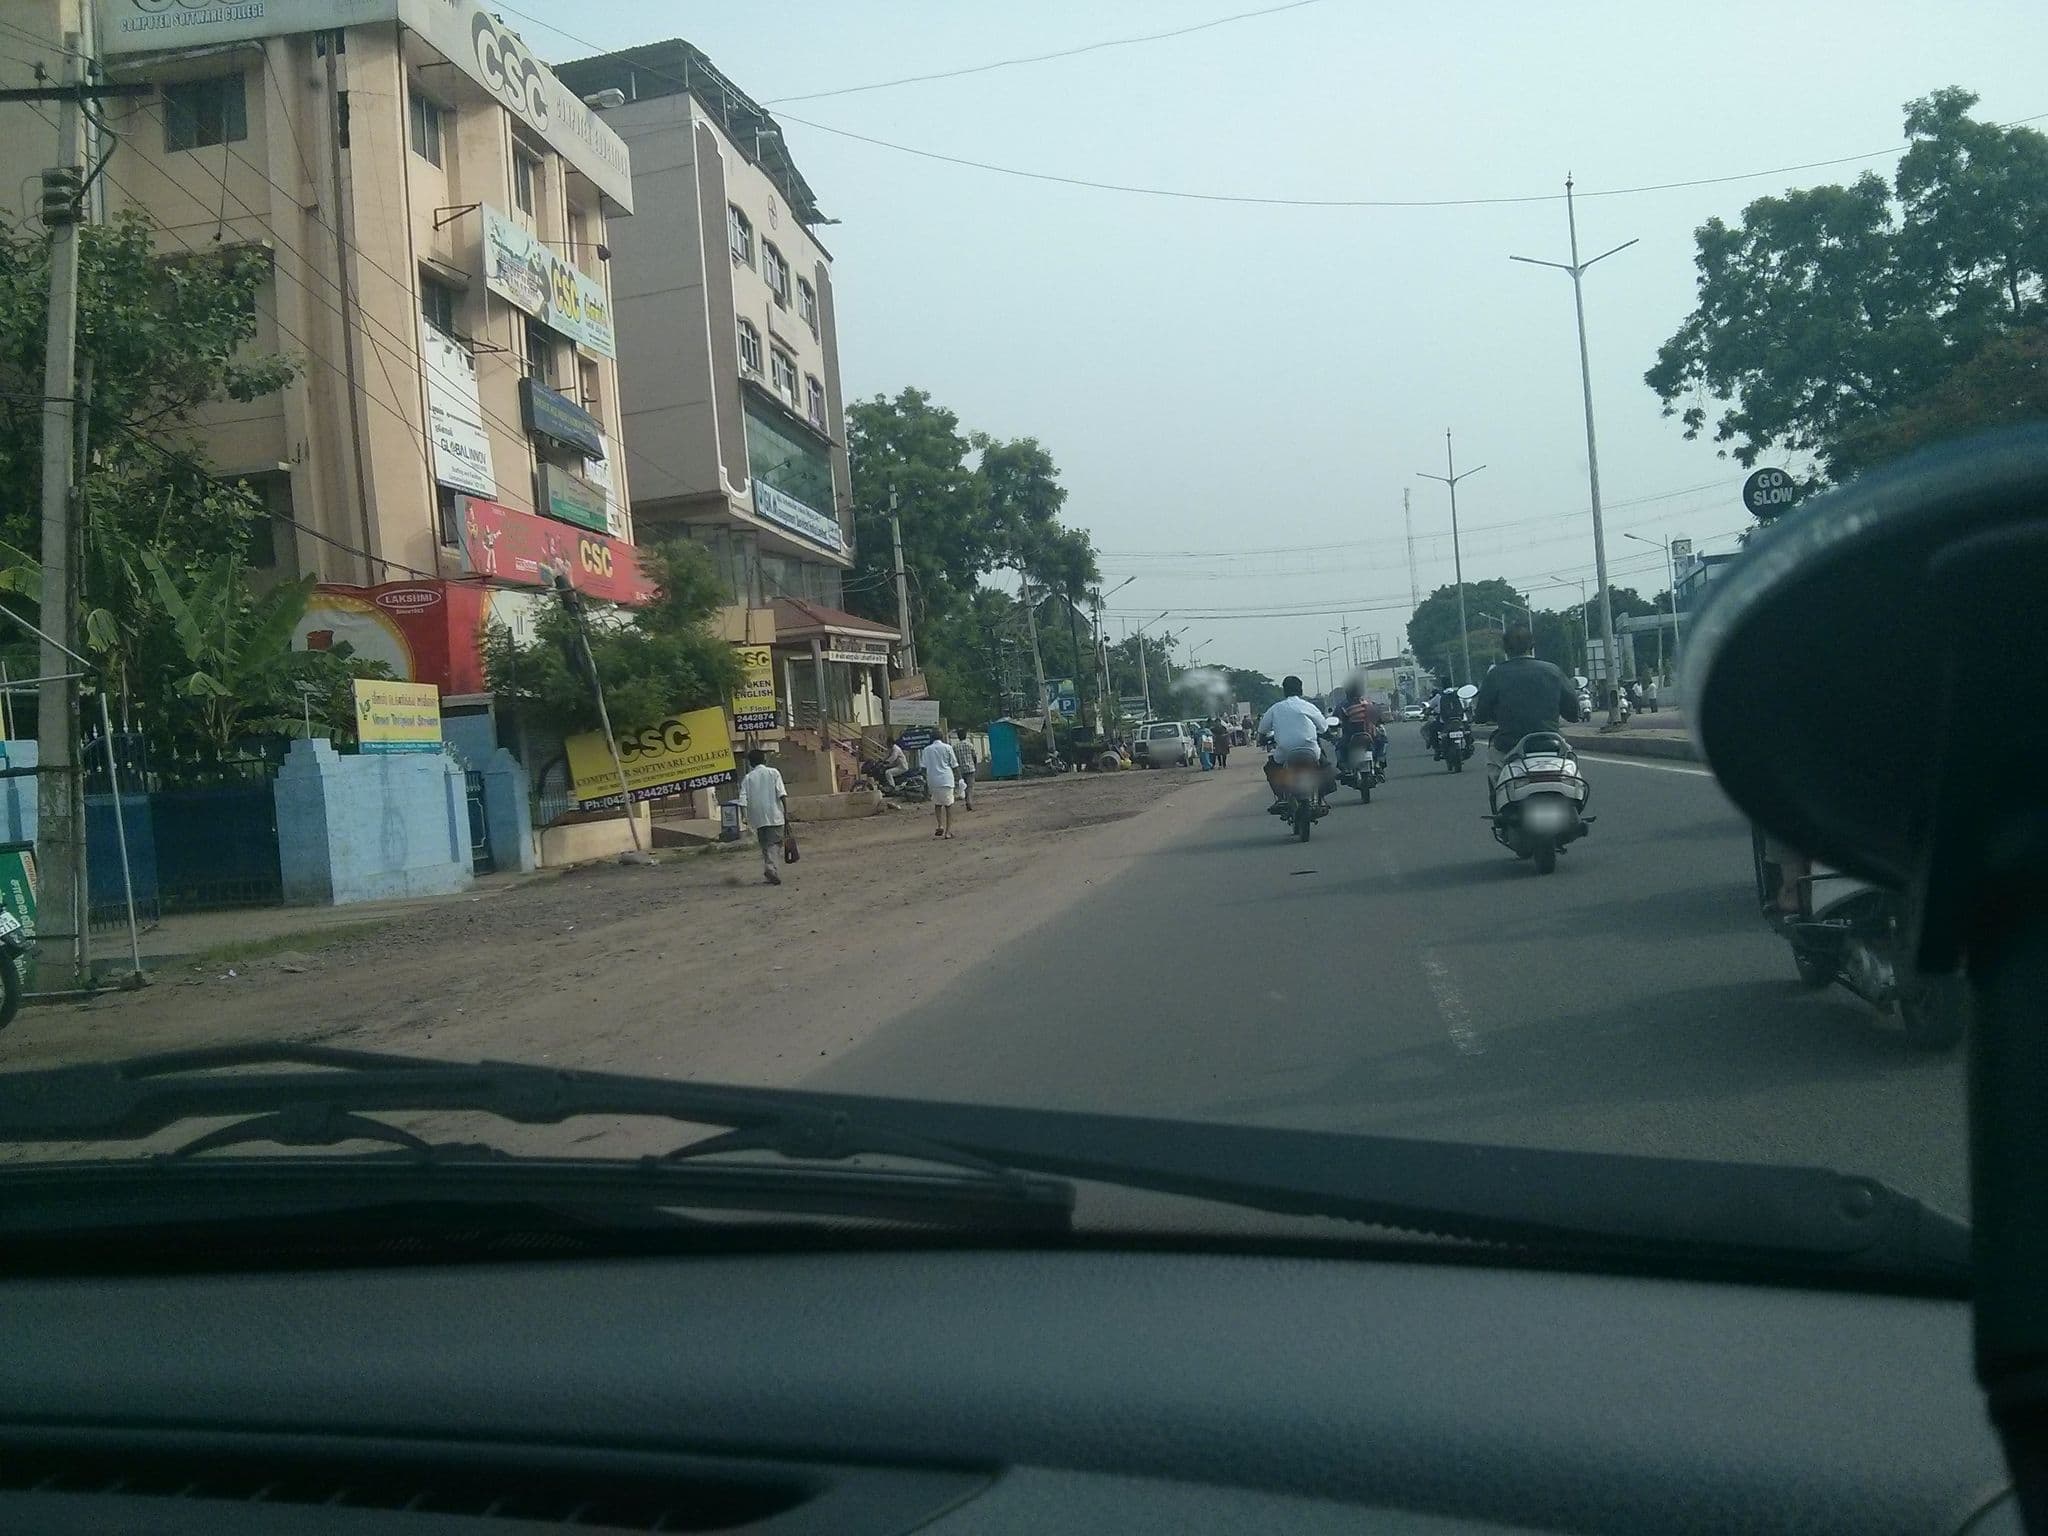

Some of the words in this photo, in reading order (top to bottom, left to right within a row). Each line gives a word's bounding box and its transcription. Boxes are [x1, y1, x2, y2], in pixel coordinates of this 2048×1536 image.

[120, 16, 171, 32] COMPUTER
[172, 9, 223, 27] SOFTWARE
[225, 3, 264, 21] COLLEGE
[473, 17, 549, 131] CSC
[551, 261, 581, 323] CSC
[1758, 472, 1783, 489] GO
[1753, 487, 1793, 506] SLOW
[579, 536, 614, 578] CSC
[385, 593, 433, 604] LAKSHMI
[736, 713, 774, 723] 2442874
[1062, 700, 1072, 711] P
[737, 721, 775, 731] 4384874
[609, 721, 692, 764] CSC
[631, 756, 685, 776] SOFTWARE
[688, 748, 730, 765] COLLEGE
[637, 783, 682, 800] 2442874
[689, 772, 732, 789] 4384874
